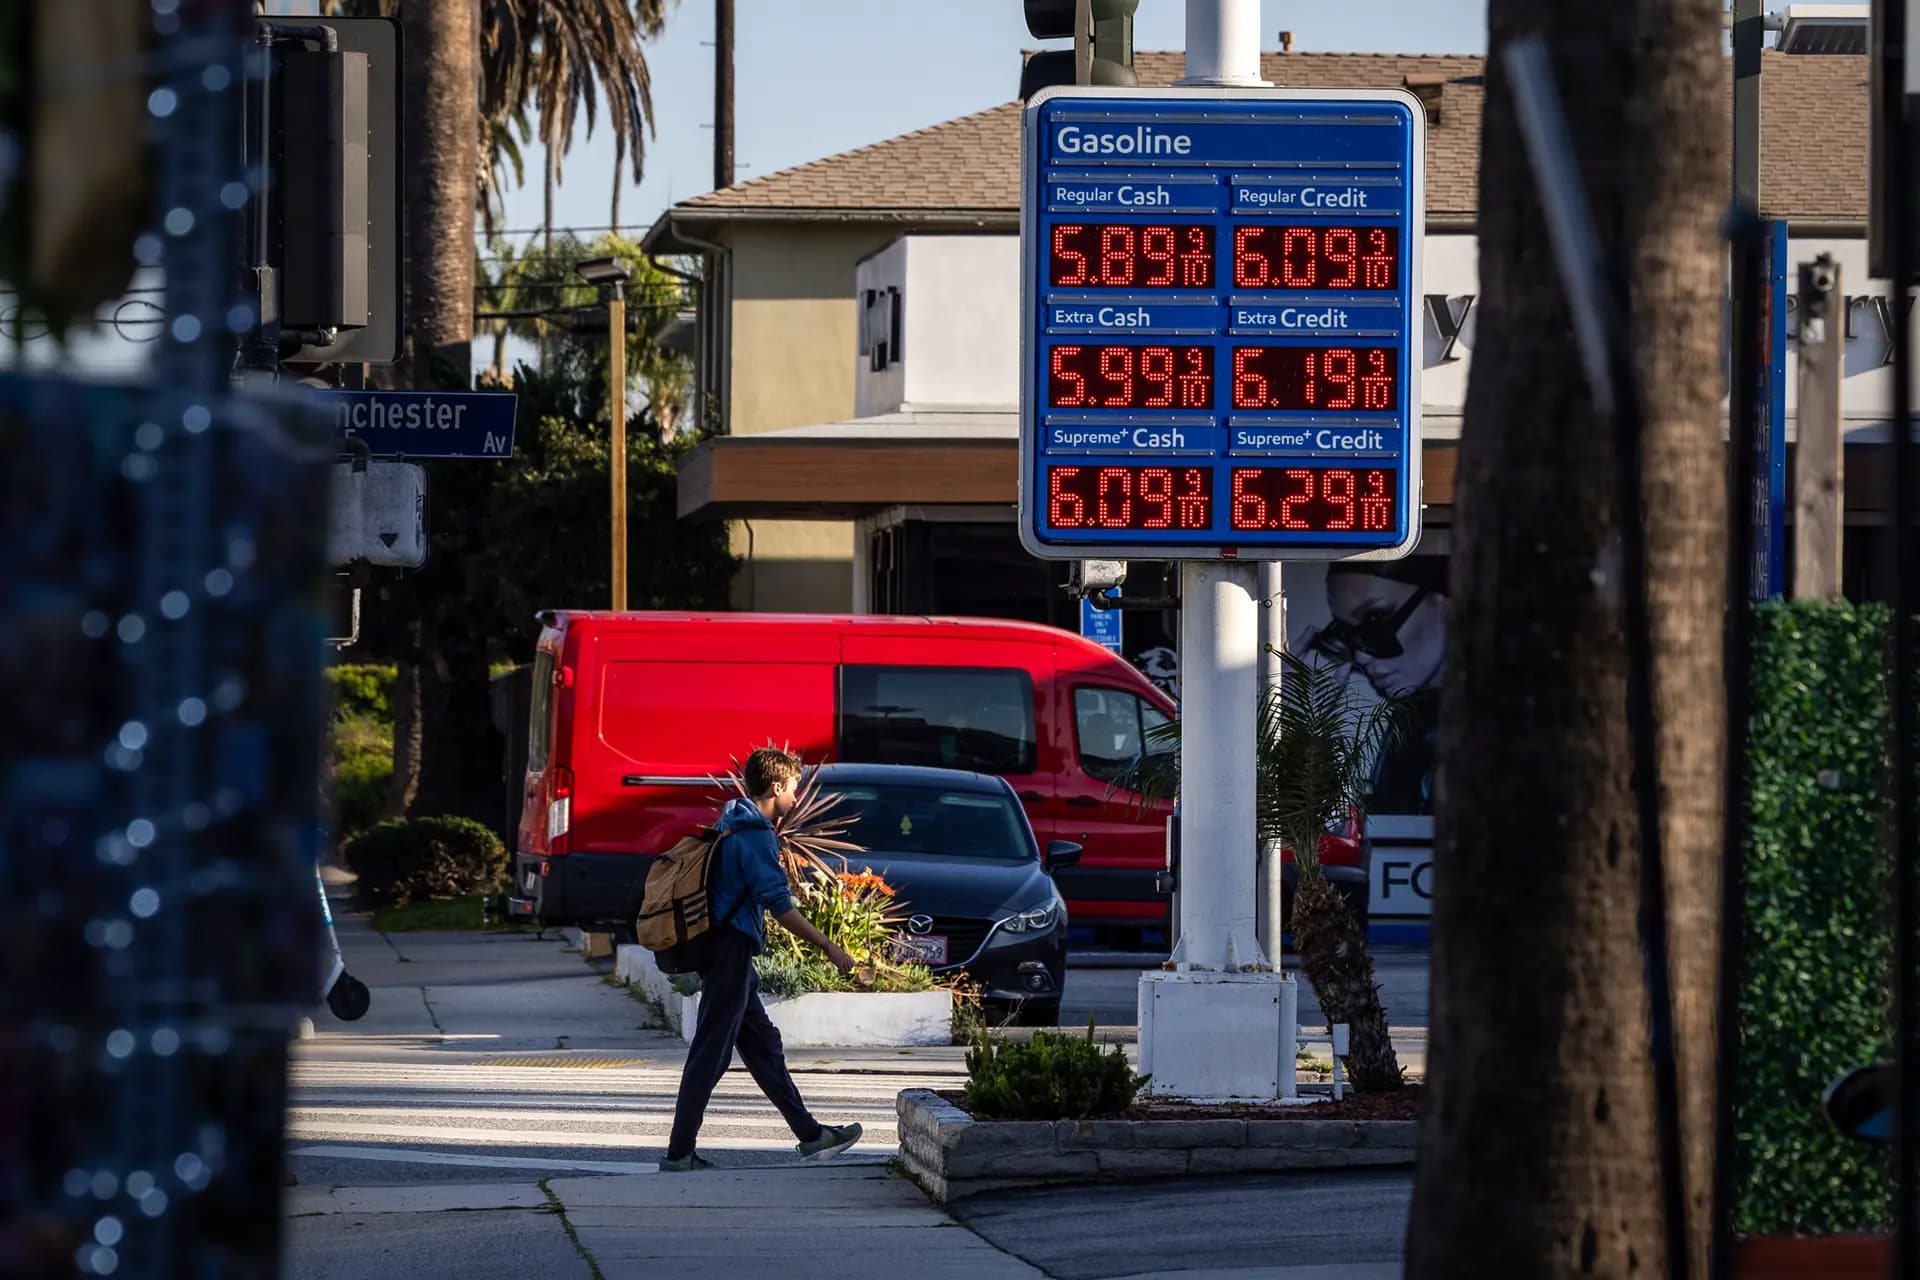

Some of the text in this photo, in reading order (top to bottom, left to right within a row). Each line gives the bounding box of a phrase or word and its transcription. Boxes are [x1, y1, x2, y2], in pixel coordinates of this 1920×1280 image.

[1058, 127, 1191, 154] Gasoline
[1057, 186, 1169, 205] Regular Cash
[1240, 188, 1366, 207] Regular Credit
[1056, 307, 1150, 326] Extra Cash
[1239, 308, 1347, 327] Extra Credit
[483, 431, 506, 453] Av
[1133, 428, 1184, 447] Cash
[1316, 430, 1382, 449] Credit
